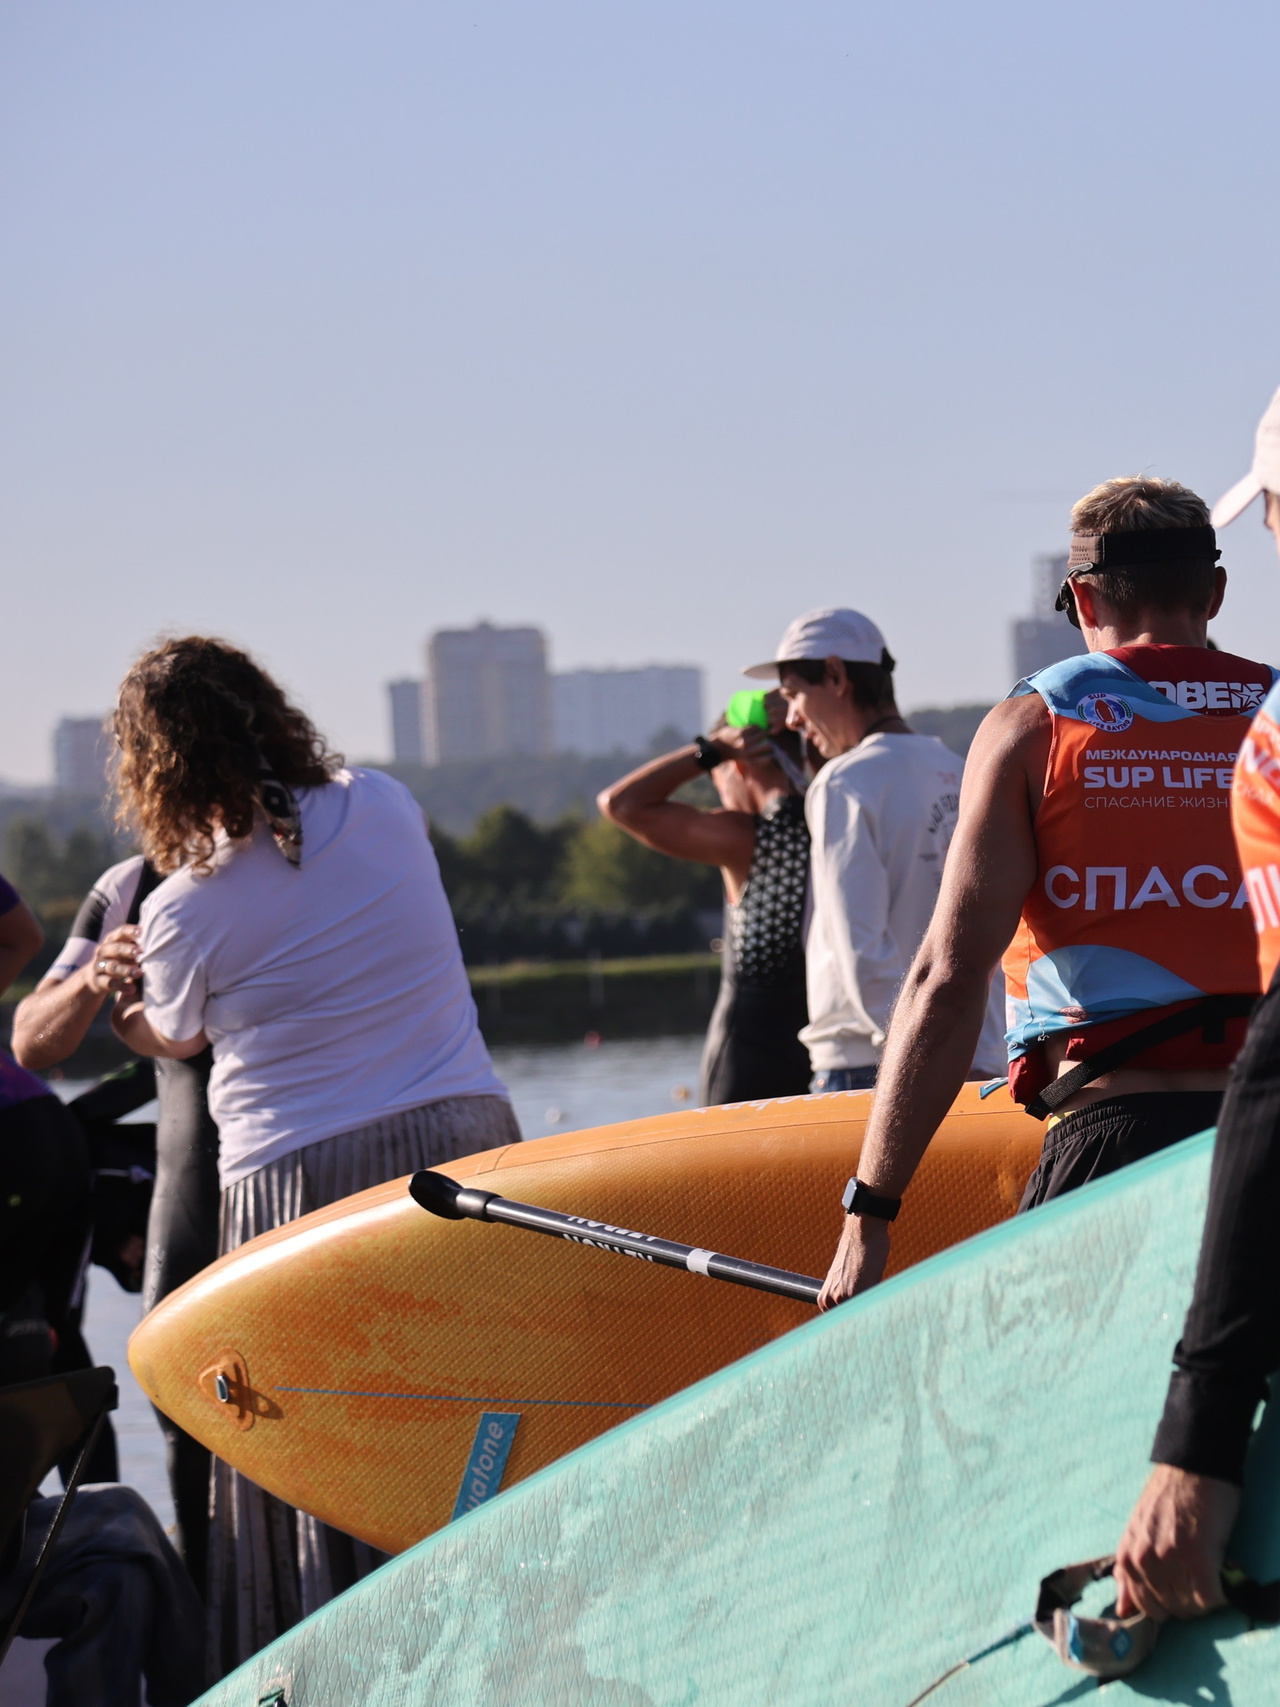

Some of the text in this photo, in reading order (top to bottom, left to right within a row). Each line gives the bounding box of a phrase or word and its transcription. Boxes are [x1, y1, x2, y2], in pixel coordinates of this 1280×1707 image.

[1085, 750, 1239, 762] МЕЖДУНАРОДНАЯ
[1084, 766, 1234, 789] SUP LIFE
[1084, 796, 1230, 809] СПАСАНИЕ ЖИЗН
